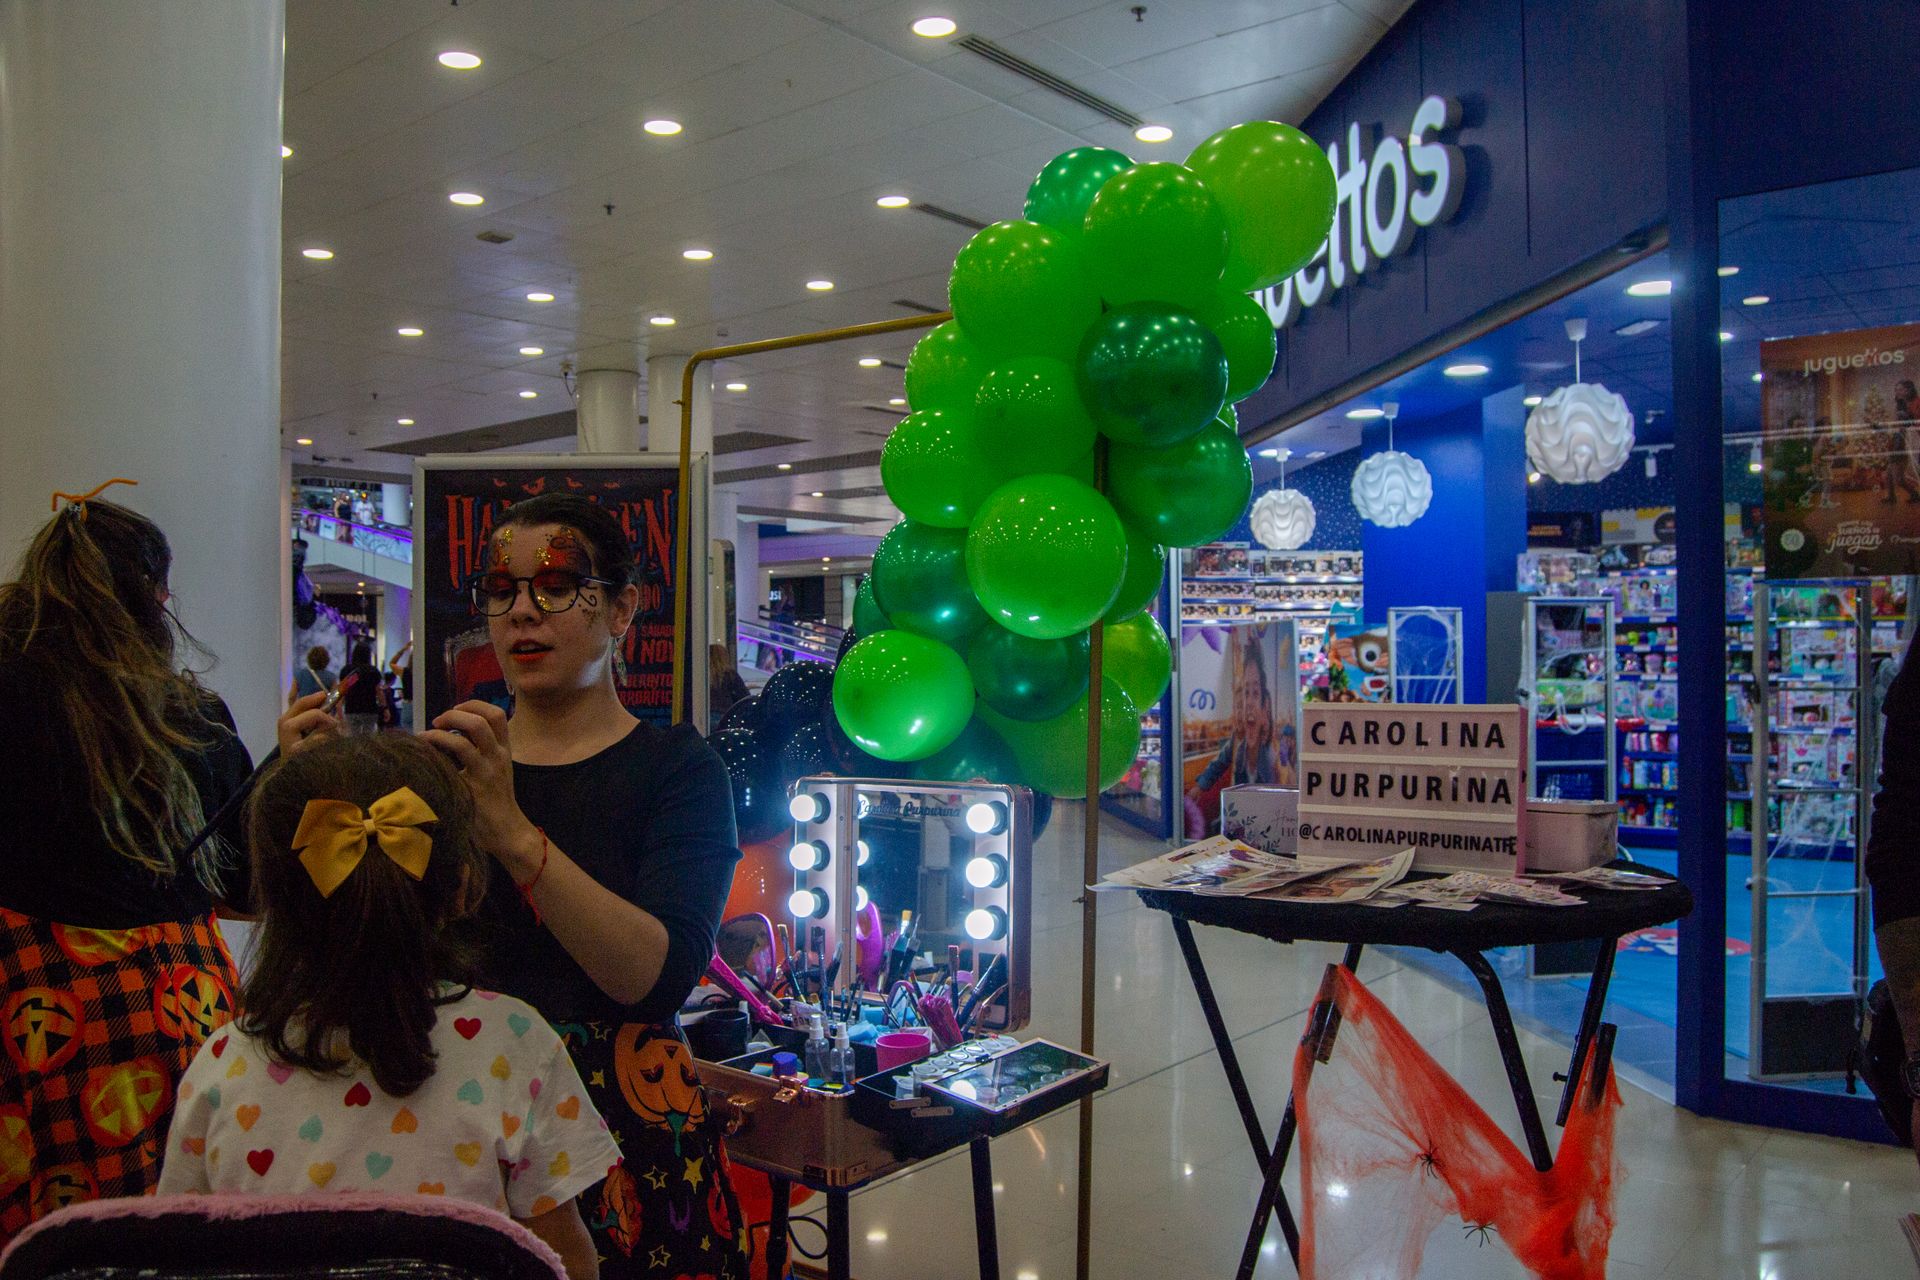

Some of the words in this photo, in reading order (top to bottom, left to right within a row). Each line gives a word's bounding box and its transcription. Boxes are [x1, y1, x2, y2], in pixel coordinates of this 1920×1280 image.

[1252, 95, 1450, 328] uettos
[1310, 720, 1505, 749] CAROLINA
[1306, 771, 1512, 804] PURPURINA
